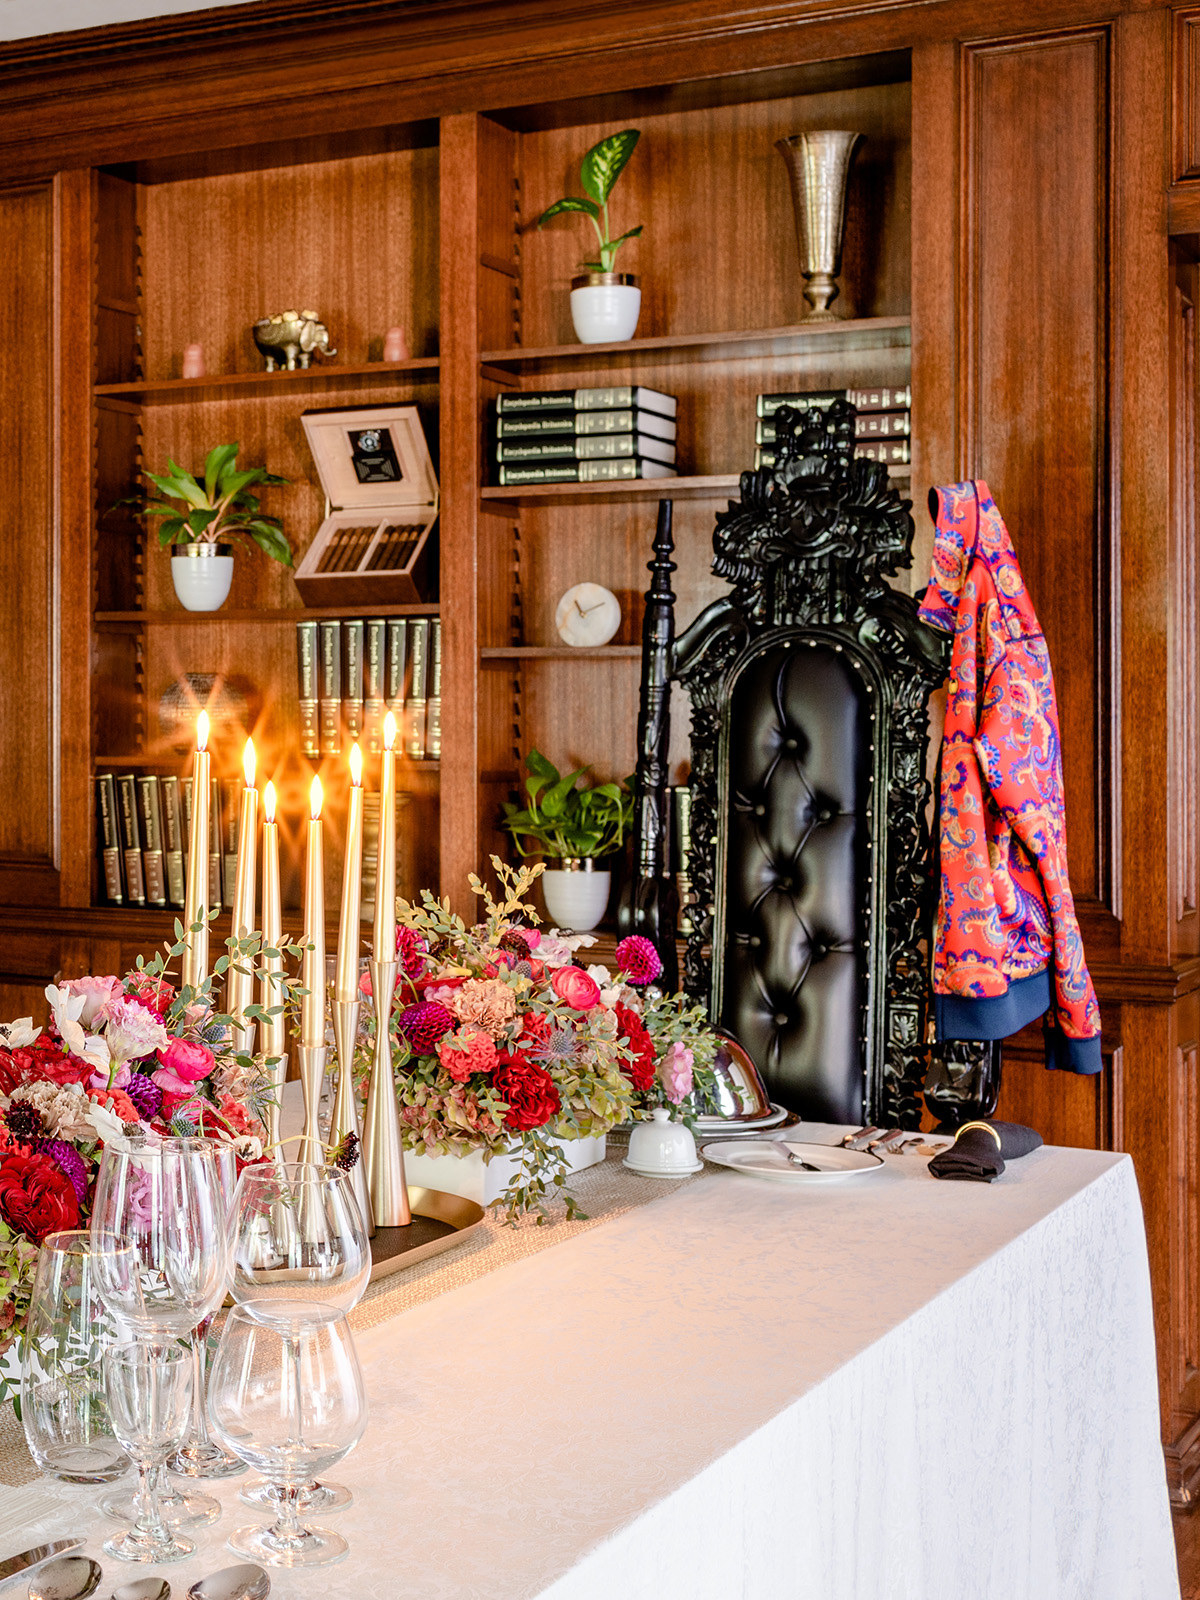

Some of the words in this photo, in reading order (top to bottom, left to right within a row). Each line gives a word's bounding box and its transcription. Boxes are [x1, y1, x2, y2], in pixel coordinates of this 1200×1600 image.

[542, 396, 572, 405] Britannica
[542, 420, 573, 429] Britannica
[542, 444, 574, 453] Britannica
[545, 468, 577, 477] Britannica
[304, 667, 312, 697] Britannica
[349, 666, 357, 696] Britannica
[413, 665, 421, 696] Britannica
[124, 818, 133, 846] Britannica
[145, 820, 153, 848] Britannica
[167, 820, 175, 848] Britannica
